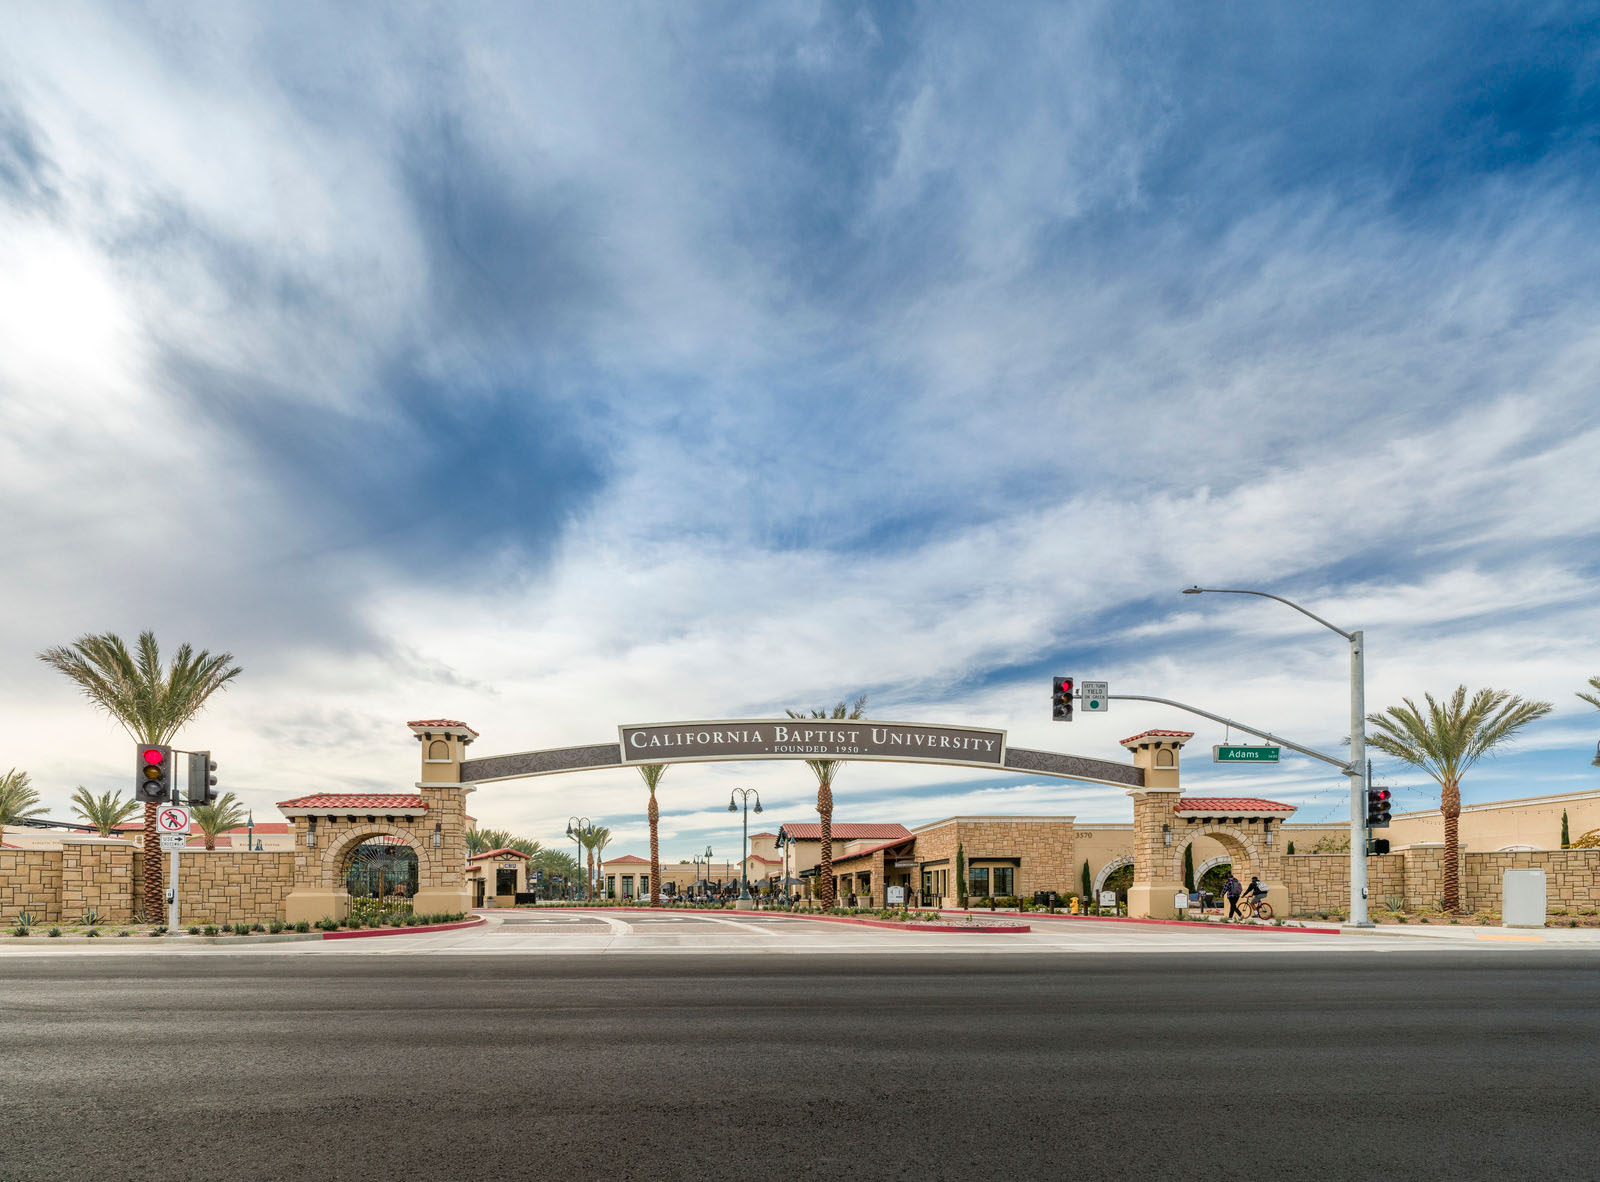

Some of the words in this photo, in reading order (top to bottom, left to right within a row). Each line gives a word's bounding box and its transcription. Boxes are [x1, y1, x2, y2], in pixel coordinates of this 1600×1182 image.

[630, 731, 763, 748] CALIFORNIA
[774, 726, 859, 743] BAPTIST
[872, 728, 995, 752] UNIVERSITY
[774, 745, 828, 753] FOUNDED
[836, 745, 859, 753] 1950
[1228, 750, 1259, 758] Adams
